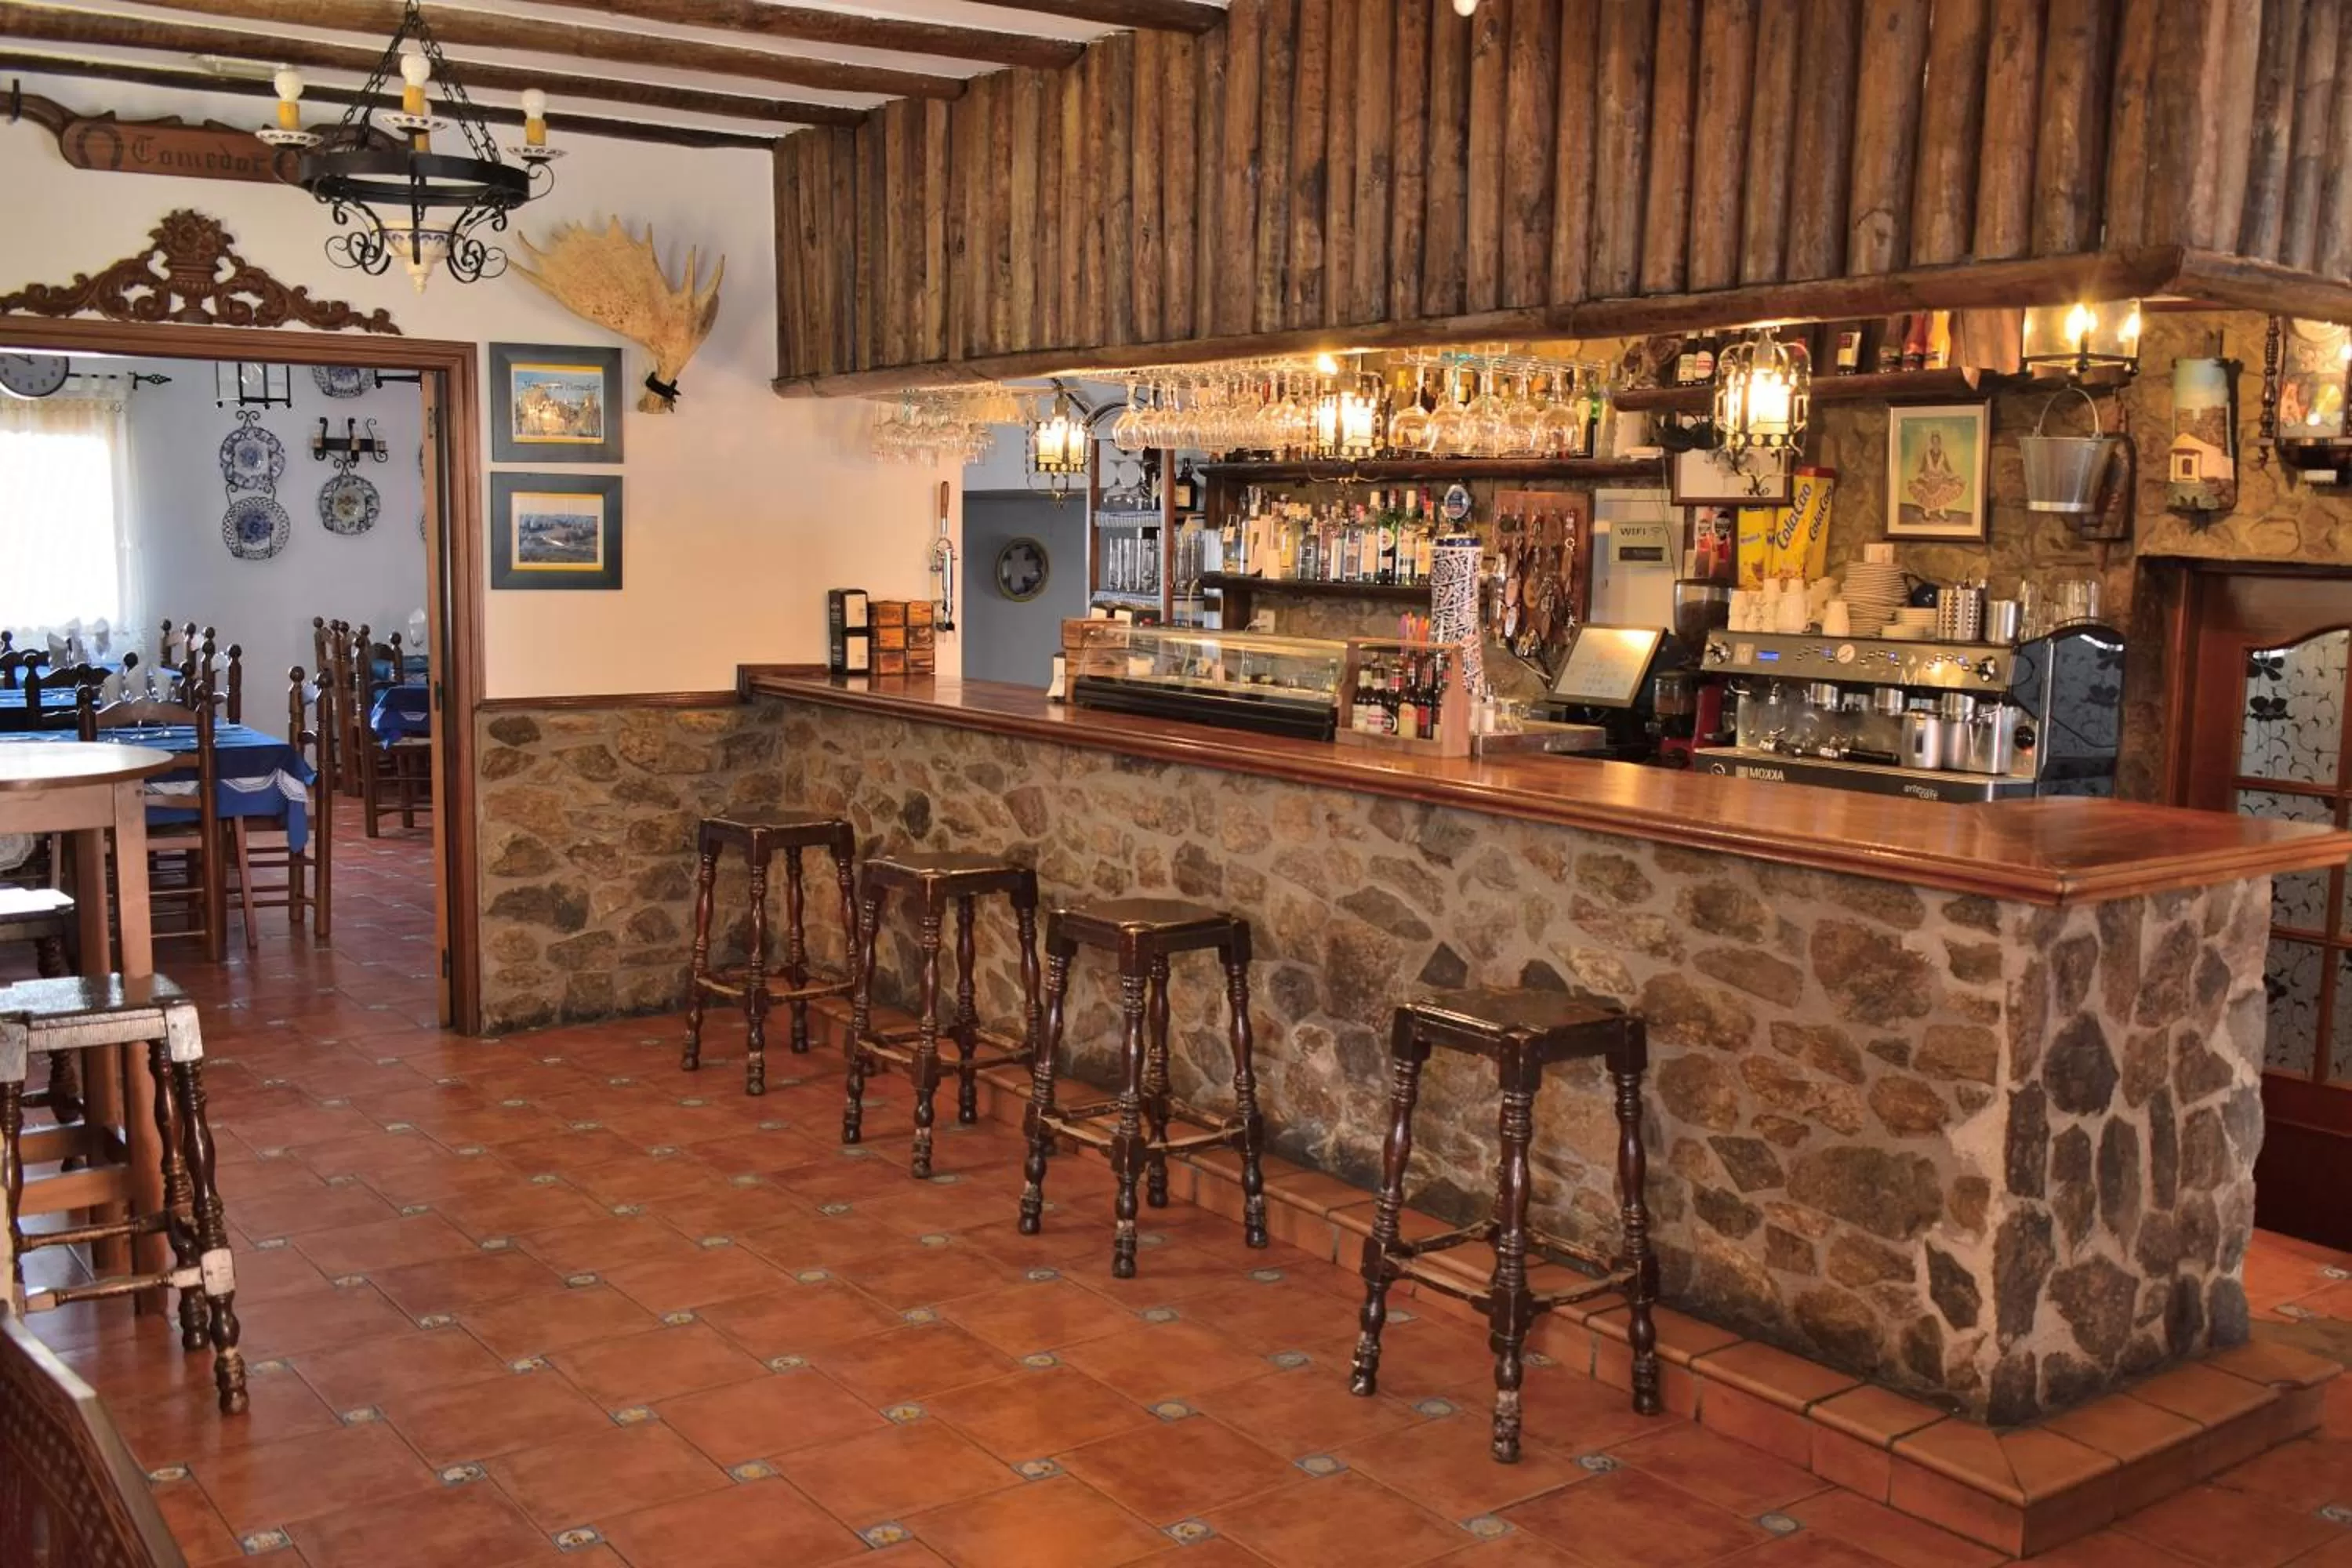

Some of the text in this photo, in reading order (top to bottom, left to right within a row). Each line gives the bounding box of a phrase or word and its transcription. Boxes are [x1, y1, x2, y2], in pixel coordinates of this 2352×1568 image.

[132, 134, 268, 172] Comedor
[1619, 526, 1647, 537] WIFI
[1776, 482, 1812, 550] ColaCao
